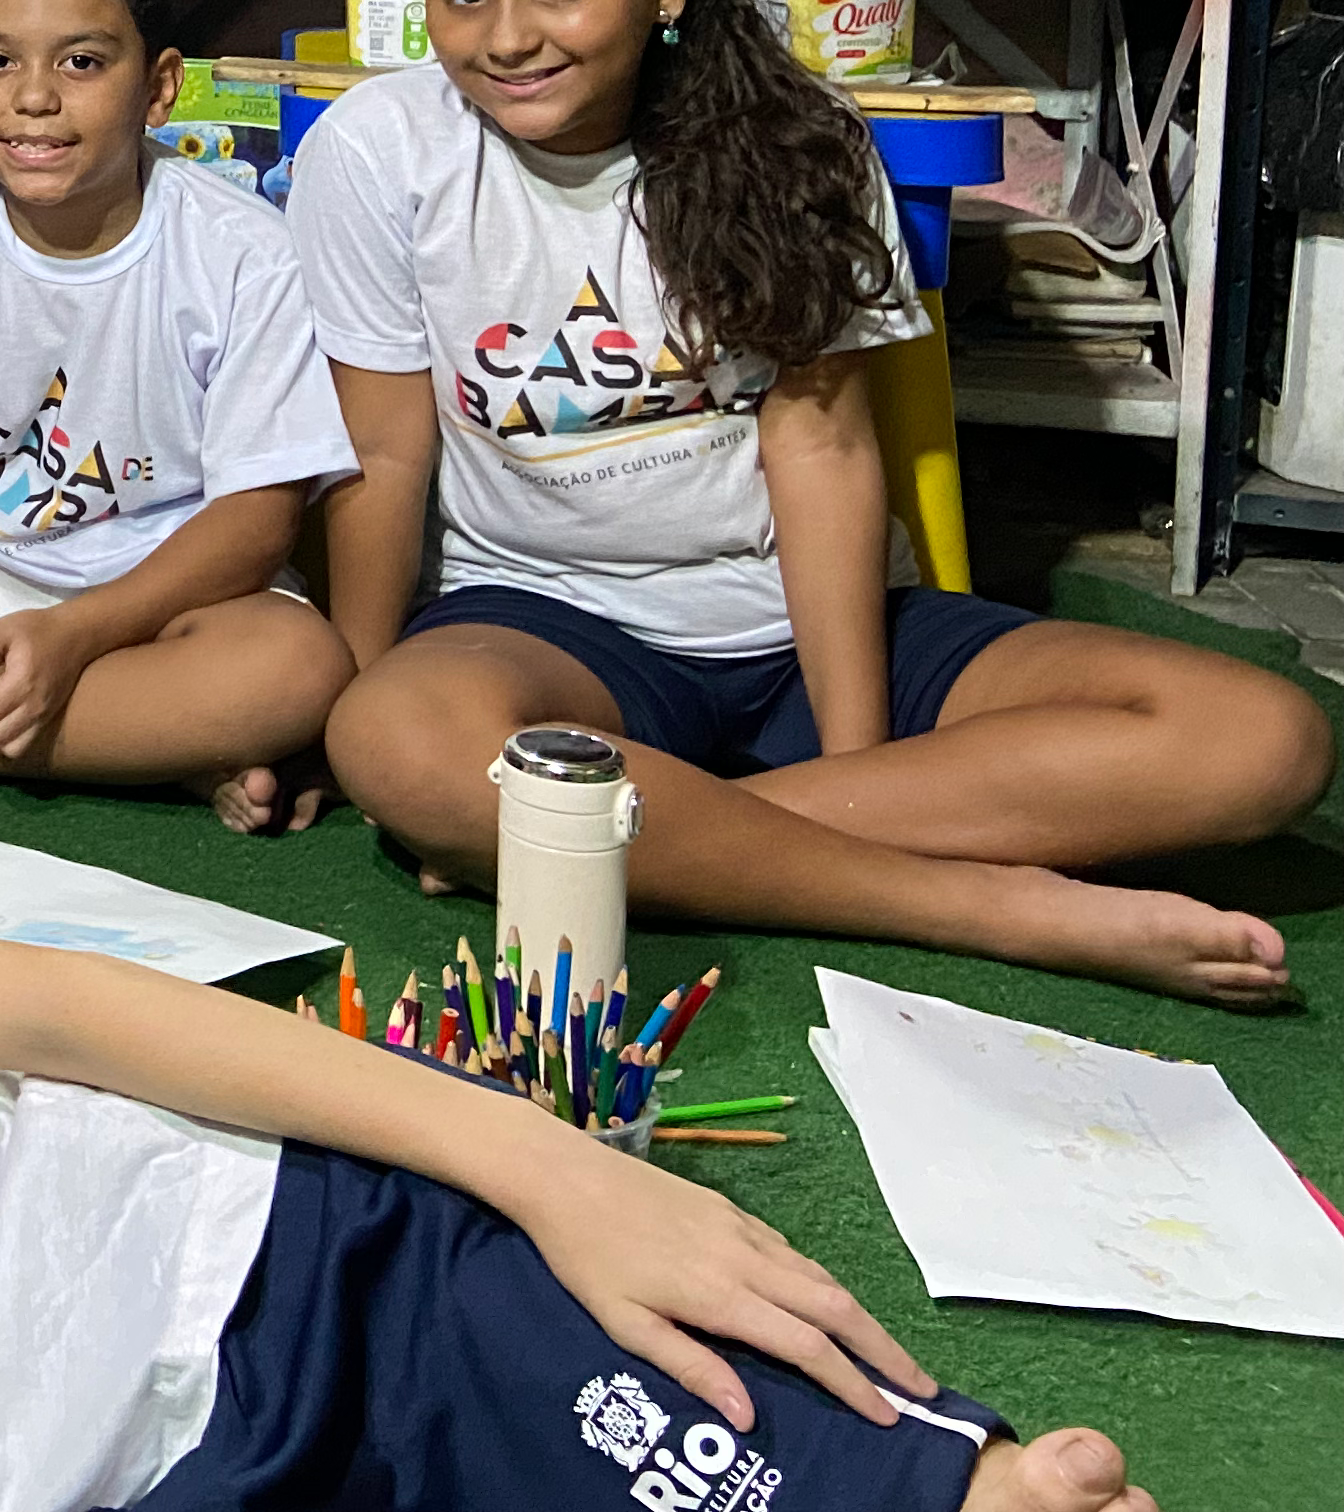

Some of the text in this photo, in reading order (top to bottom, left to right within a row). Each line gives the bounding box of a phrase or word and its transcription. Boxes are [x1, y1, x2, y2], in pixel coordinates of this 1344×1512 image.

[566, 265, 619, 323] A
[475, 322, 706, 390] CASA
[120, 455, 155, 482] DE
[596, 427, 748, 481] DE CULTURA ARTES
